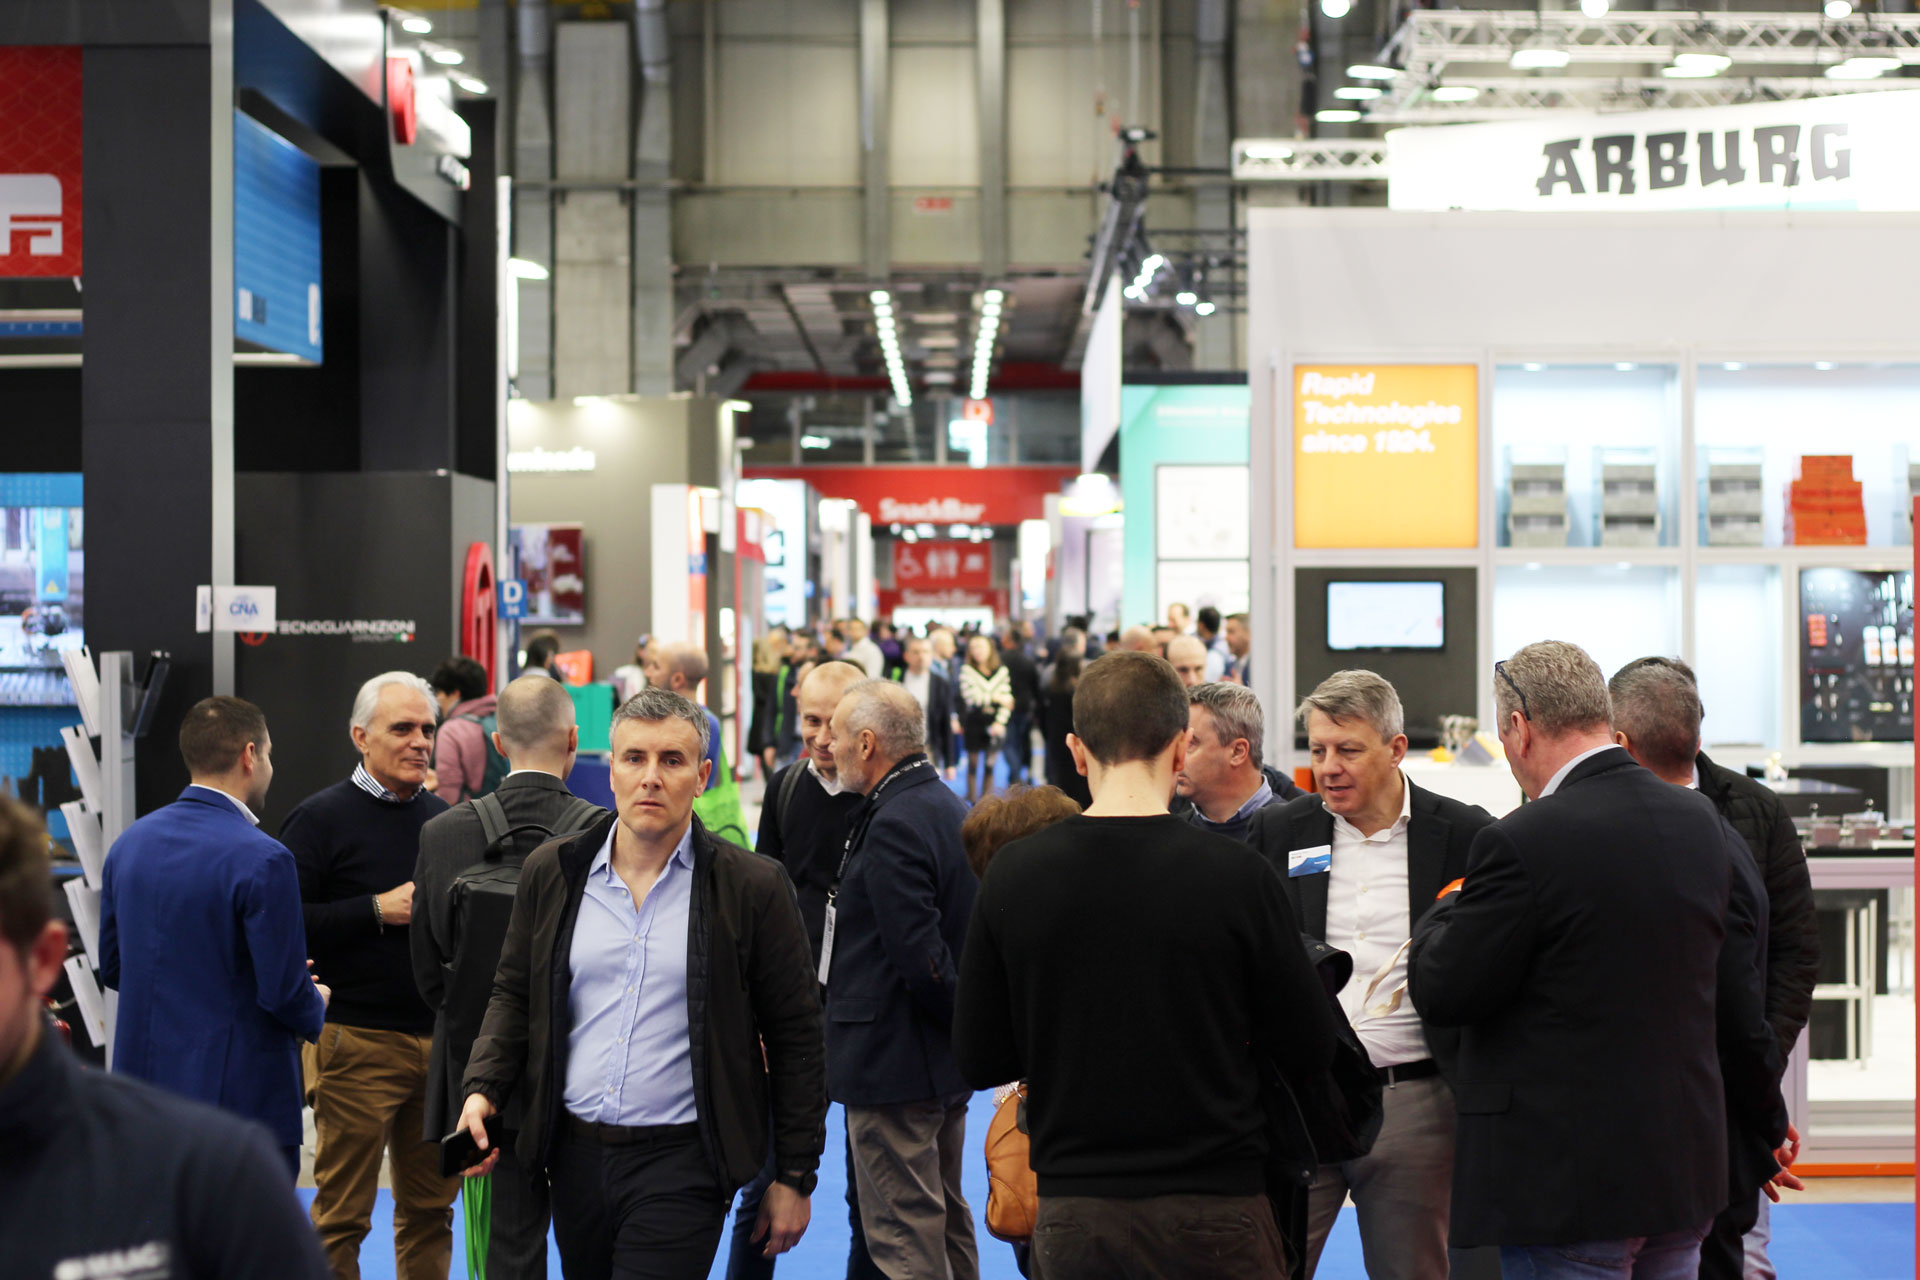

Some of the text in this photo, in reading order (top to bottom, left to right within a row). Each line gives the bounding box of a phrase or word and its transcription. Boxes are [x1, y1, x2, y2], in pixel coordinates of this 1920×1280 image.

[1536, 124, 1850, 196] ARBURG
[1301, 372, 1375, 398] Rapid
[1302, 401, 1462, 429] Technologies
[1301, 430, 1368, 453] since
[879, 497, 985, 522] SnackBar
[503, 581, 523, 603] D
[230, 603, 258, 615] CNA
